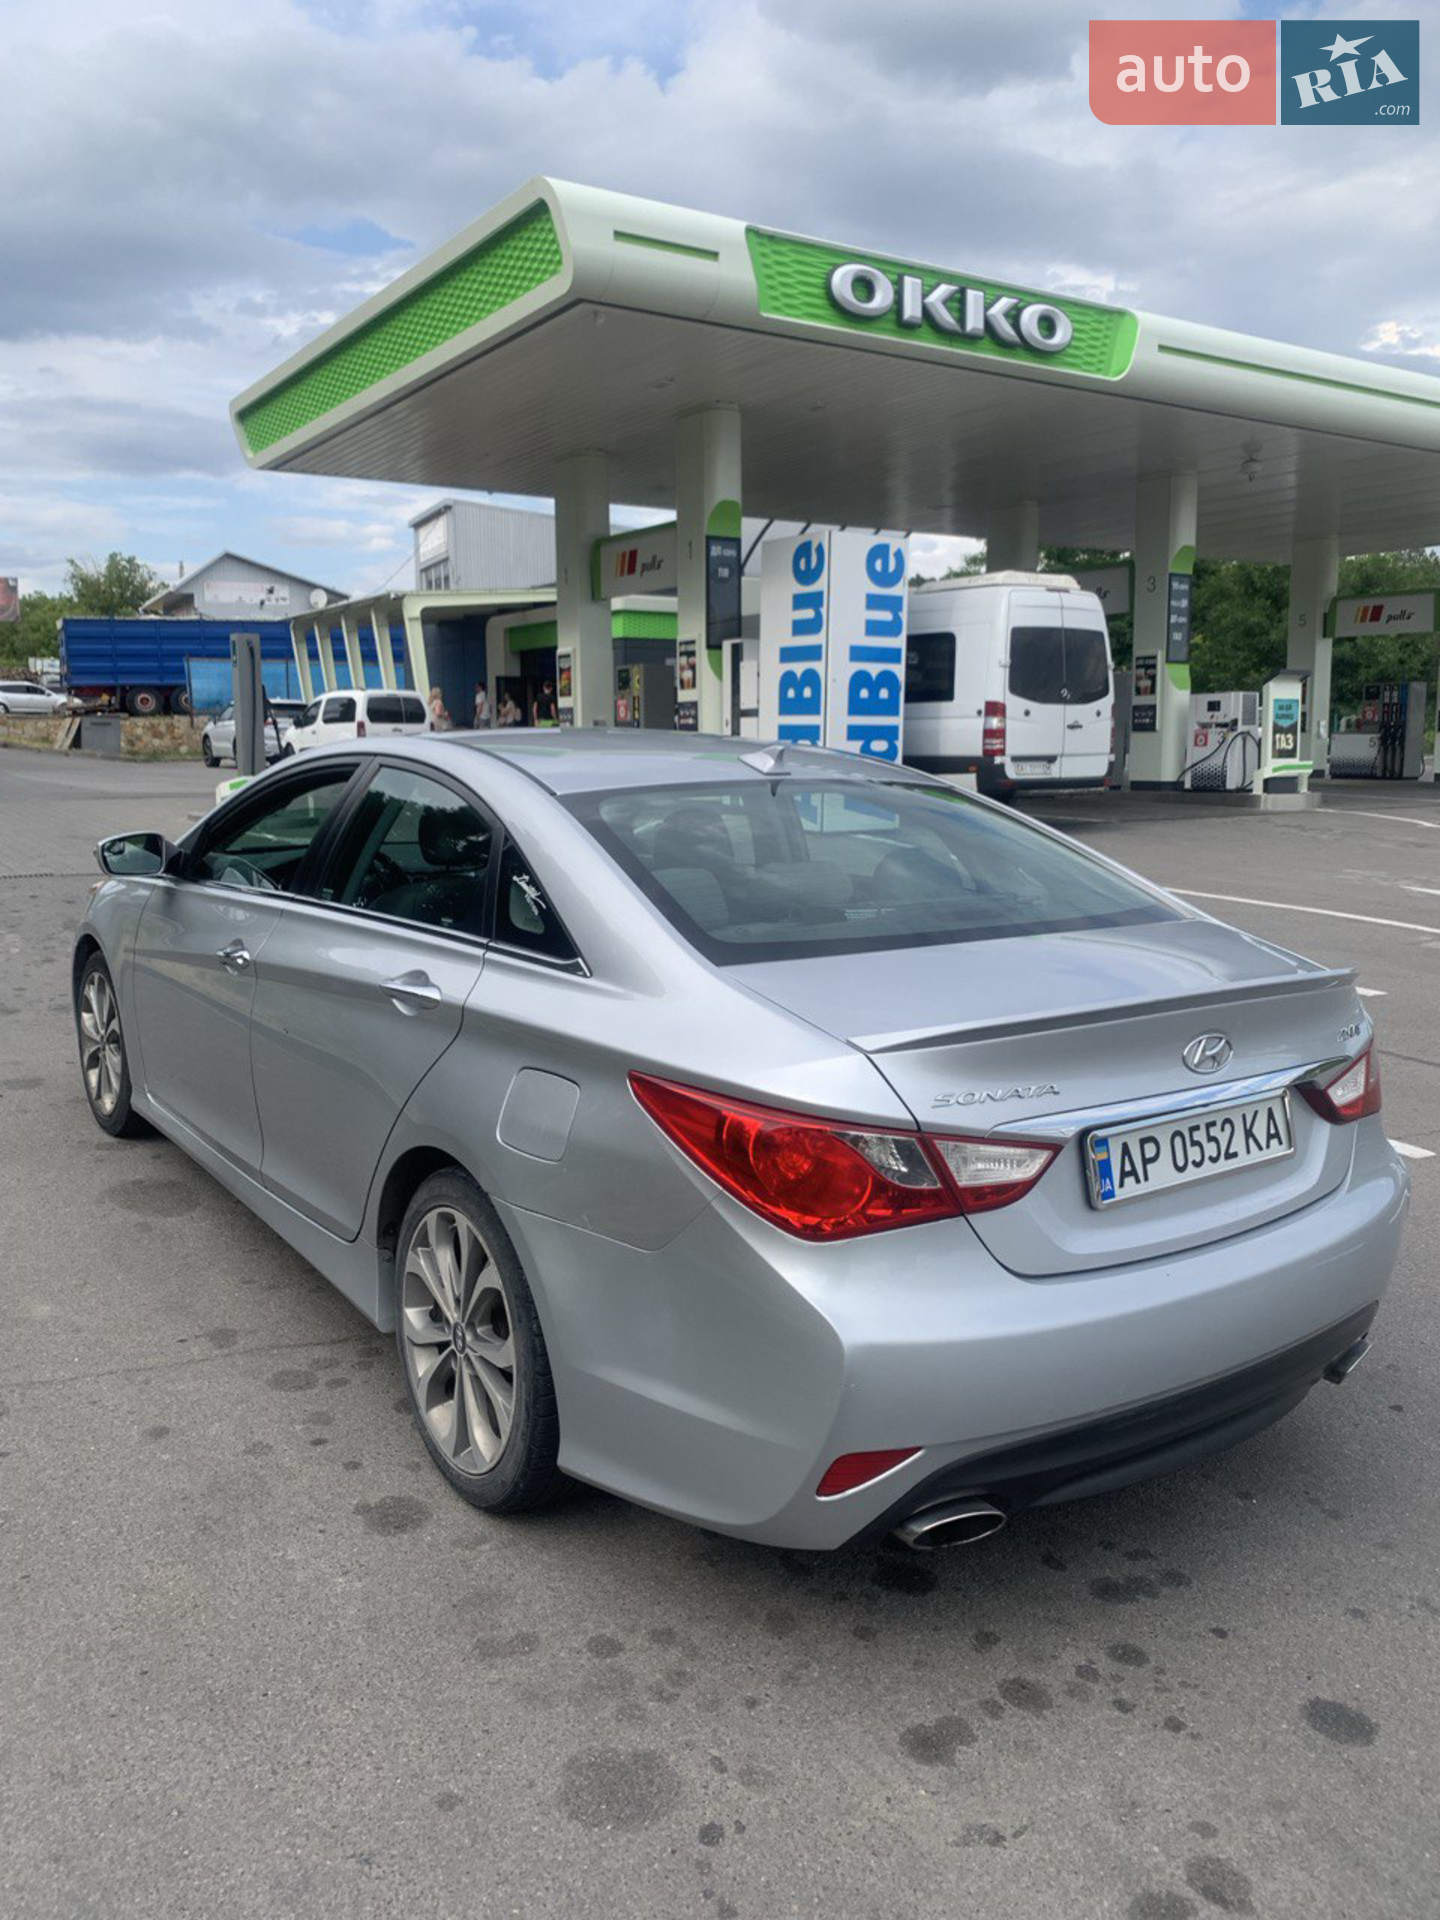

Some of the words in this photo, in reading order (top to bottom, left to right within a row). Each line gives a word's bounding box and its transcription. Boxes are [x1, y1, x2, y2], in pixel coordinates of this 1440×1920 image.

[828, 262, 1074, 354] OKKO
[1147, 575, 1156, 592] 3
[1298, 613, 1307, 628] 5
[931, 1083, 1060, 1109] SONATA
[1118, 1135, 1161, 1189] AP
[1170, 1117, 1238, 1173] 0552
[1241, 1106, 1284, 1155] KA
